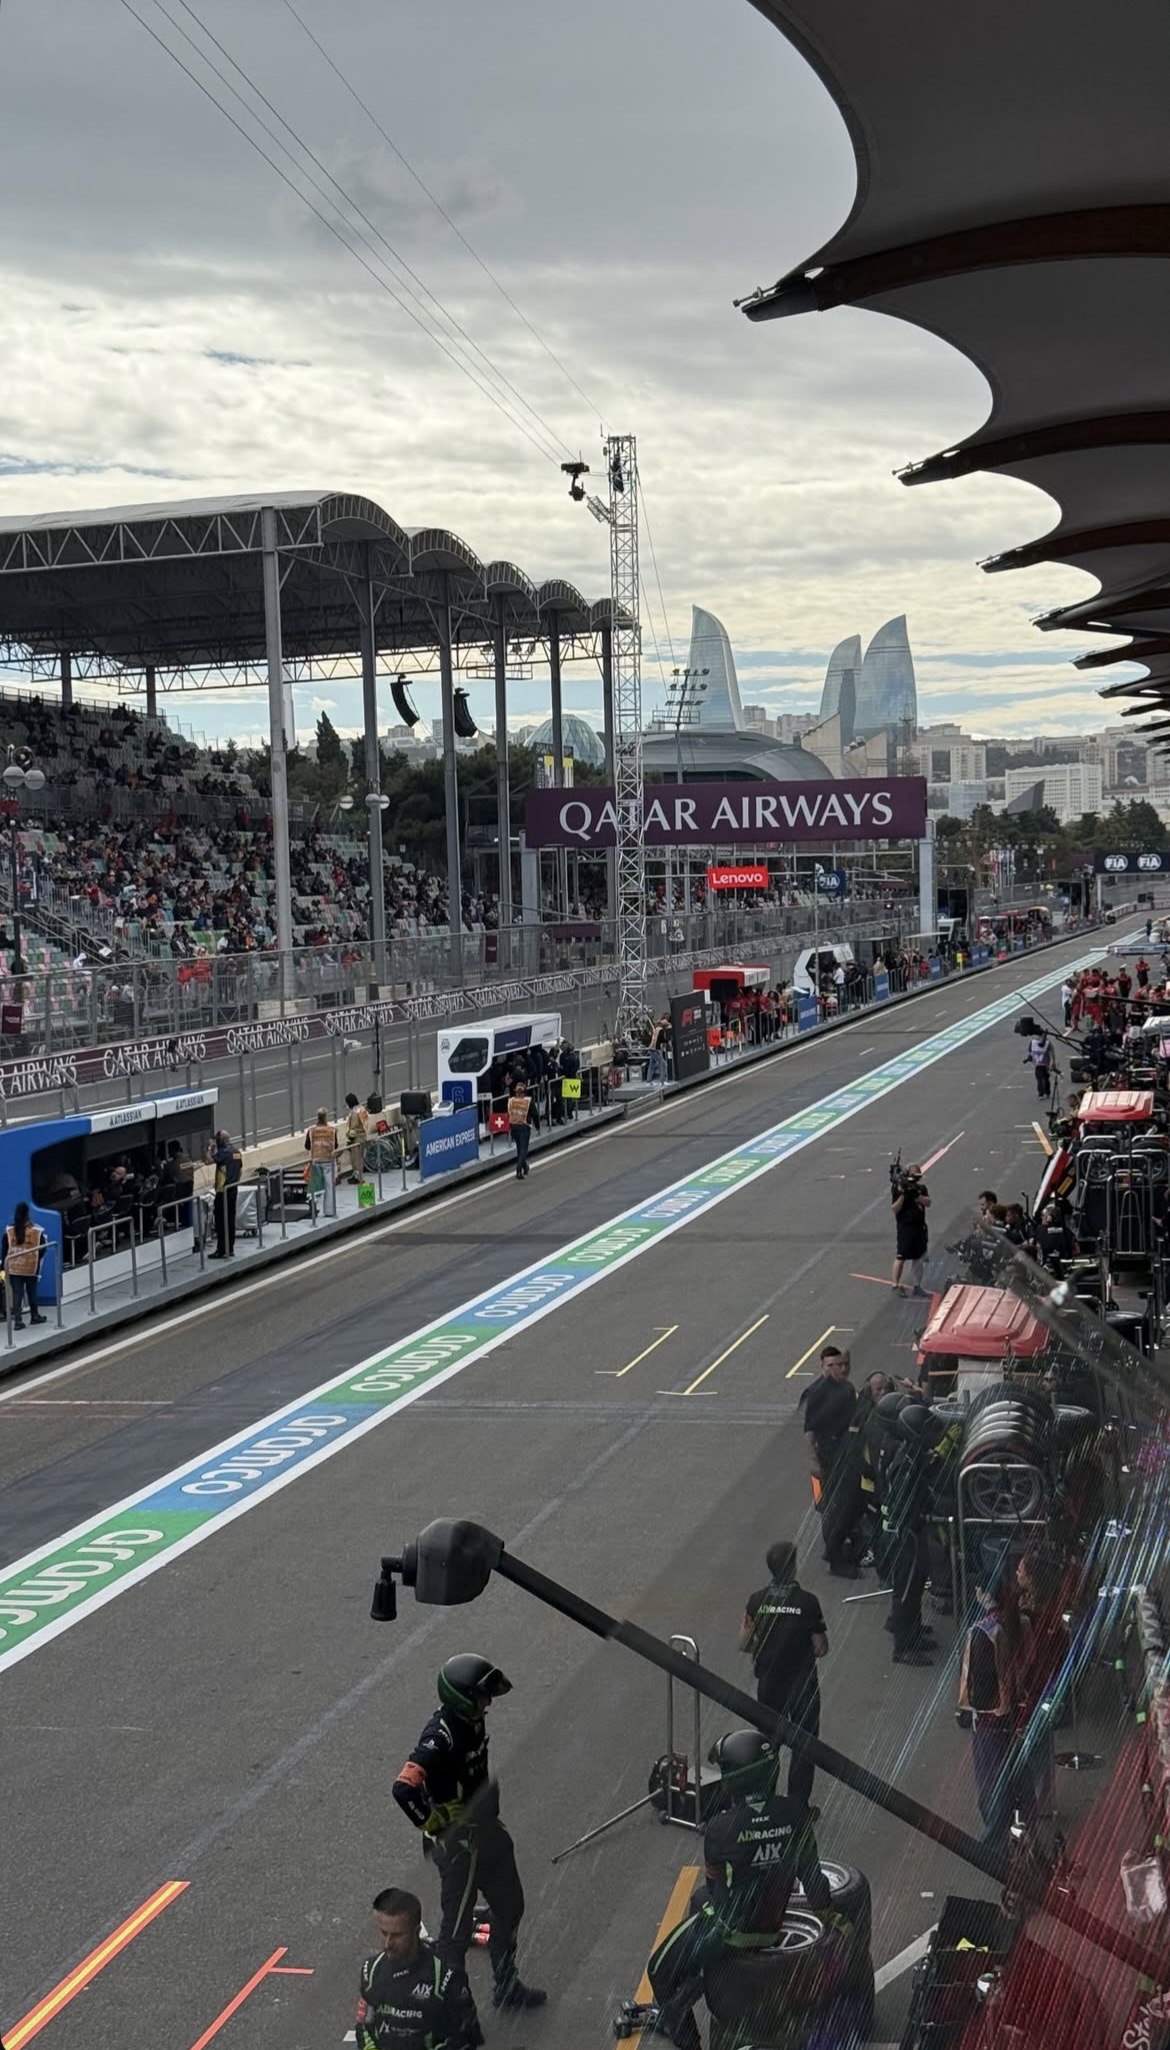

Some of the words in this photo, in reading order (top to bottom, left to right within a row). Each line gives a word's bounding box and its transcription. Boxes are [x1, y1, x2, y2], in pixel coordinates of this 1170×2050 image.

[559, 798, 699, 841] QATAR
[711, 792, 893, 829] AIRWAYS
[712, 872, 763, 884] Lenovo
[569, 1084, 579, 1093] W
[115, 1109, 142, 1125] ATLASSIAN
[426, 1135, 455, 1157] AMERICAN
[474, 1274, 575, 1318] aramco
[350, 1334, 477, 1392] aramco
[181, 1415, 347, 1495] aramco
[0, 1529, 164, 1640] aramc
[752, 1842, 782, 1862] AIX
